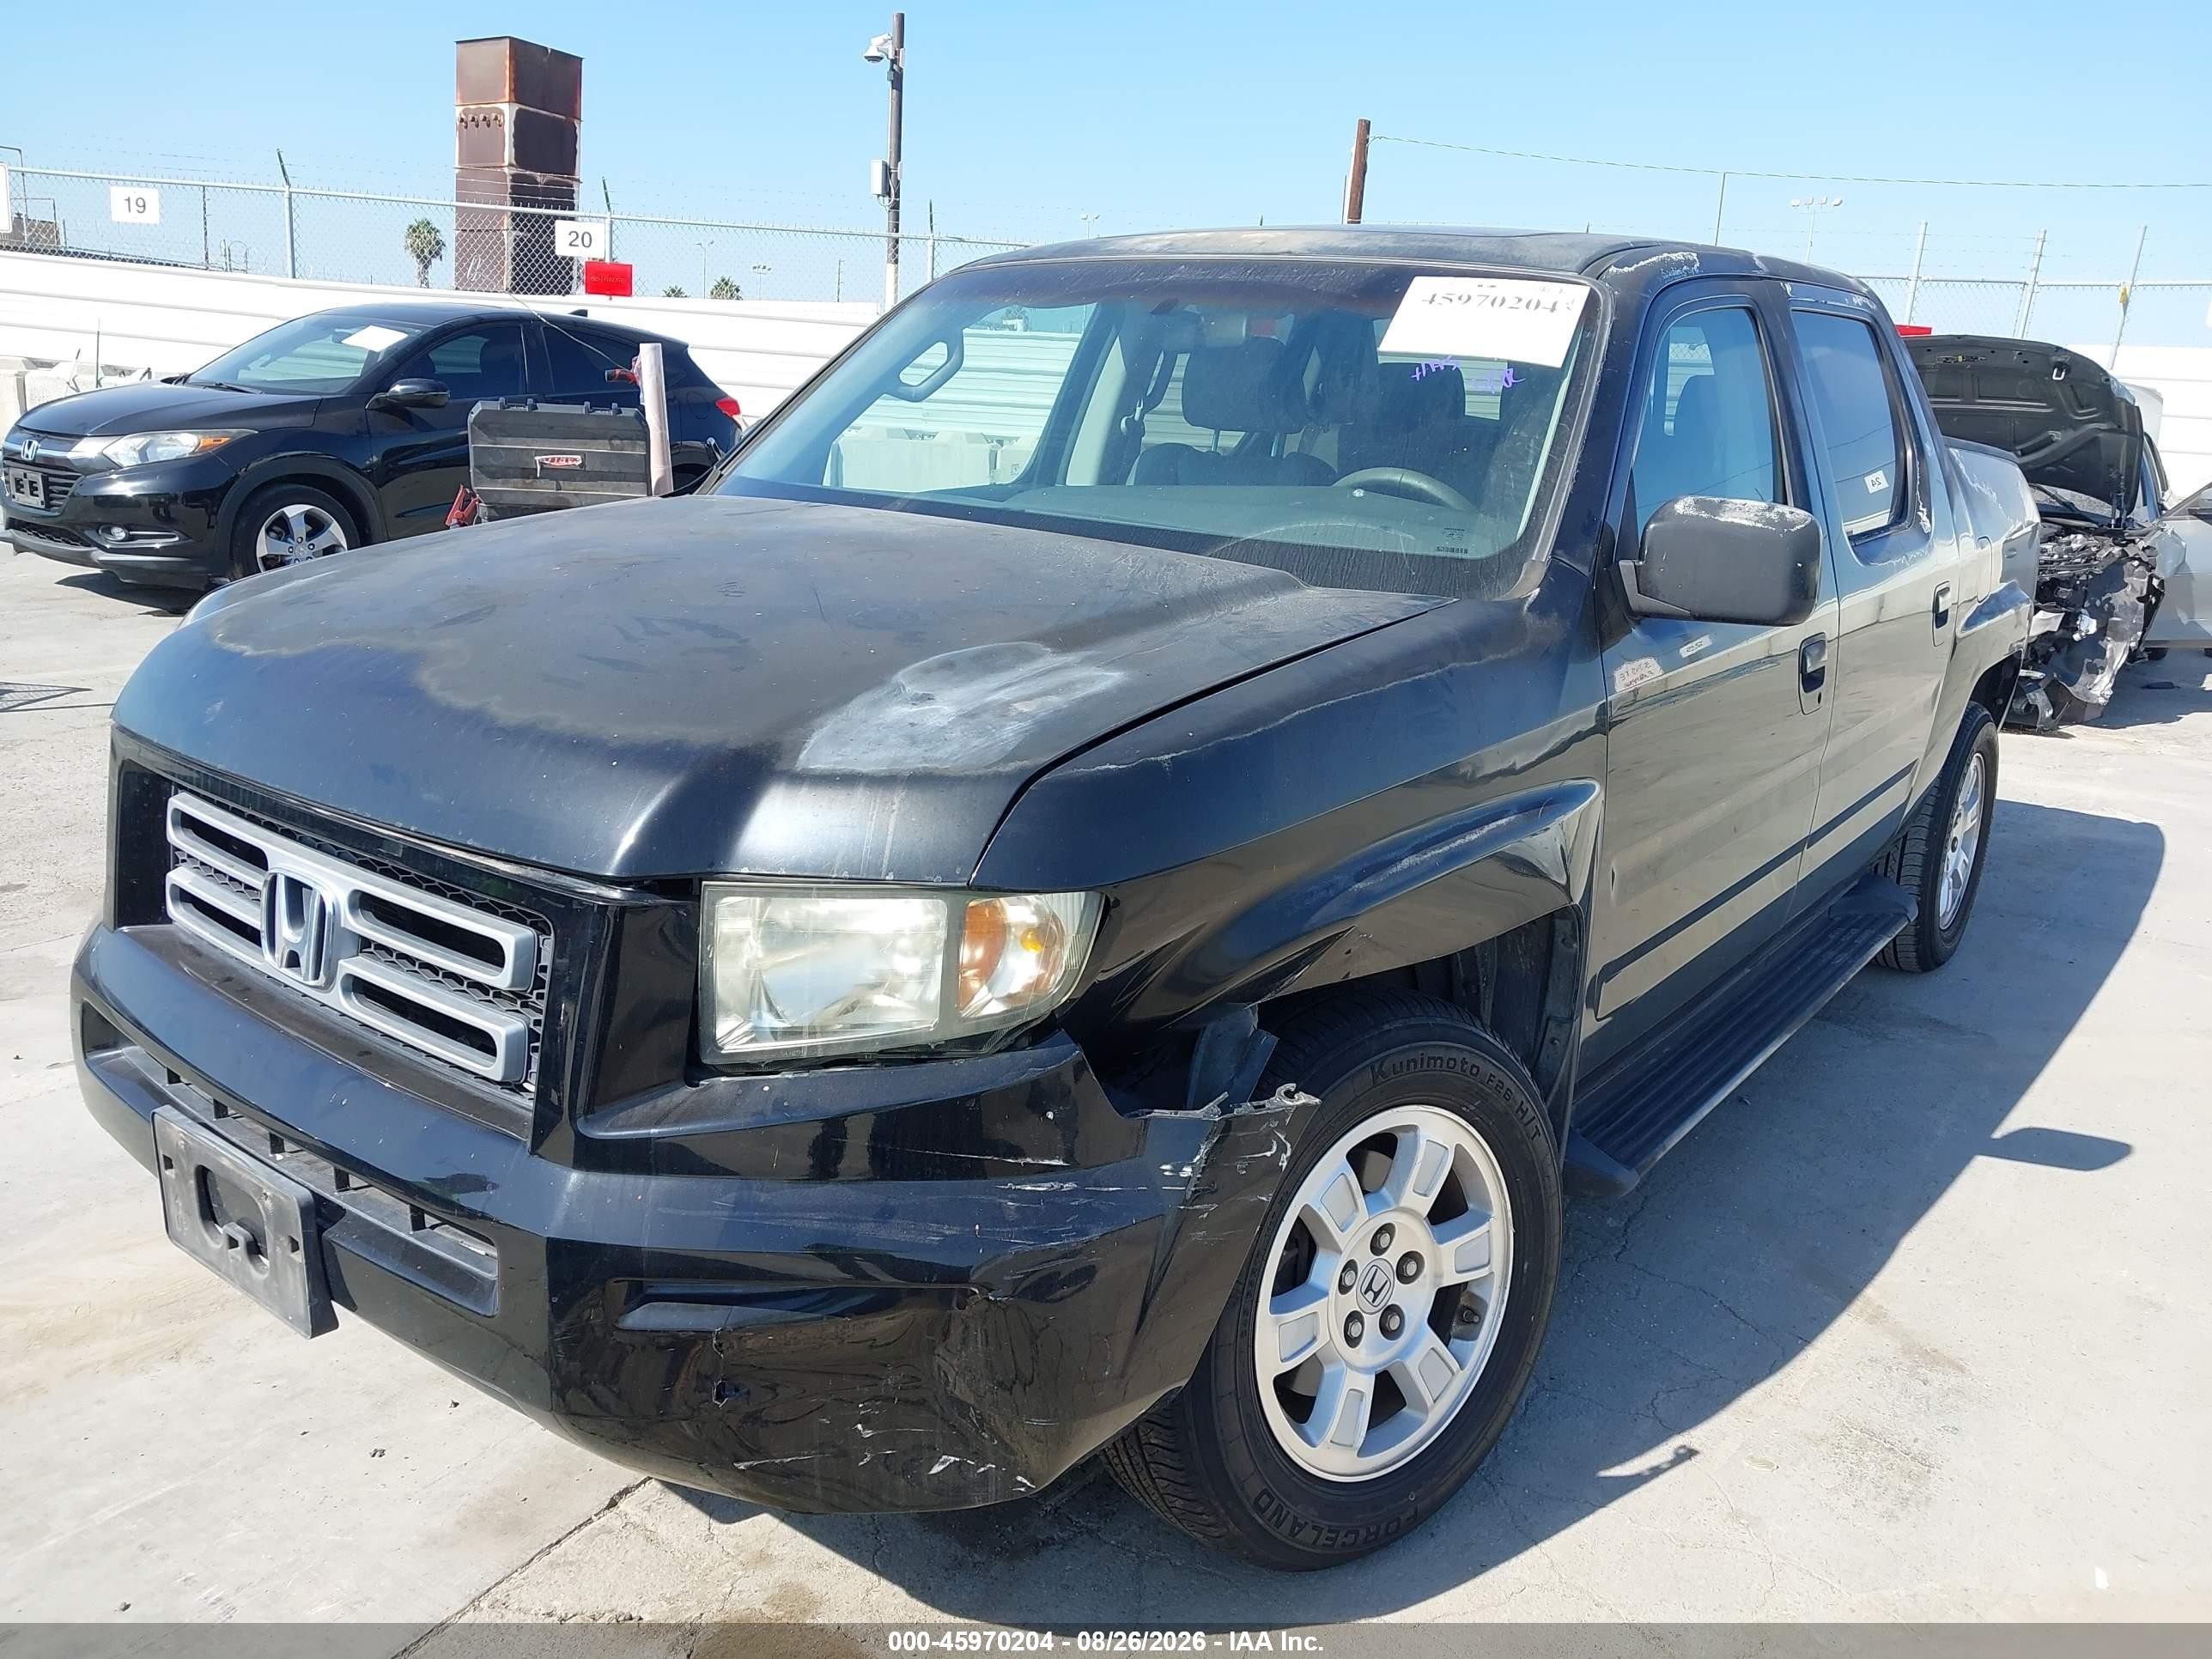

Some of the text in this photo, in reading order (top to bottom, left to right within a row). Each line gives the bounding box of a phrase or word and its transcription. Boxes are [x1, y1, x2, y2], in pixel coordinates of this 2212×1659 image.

[124, 197, 146, 213] 19
[568, 230, 592, 248] 20
[1421, 292, 1558, 313] 45970204
[1370, 1053, 1481, 1085] Kunimoto
[1515, 1101, 1541, 1141] H/T
[1254, 1488, 1419, 1547] FORCELAND
